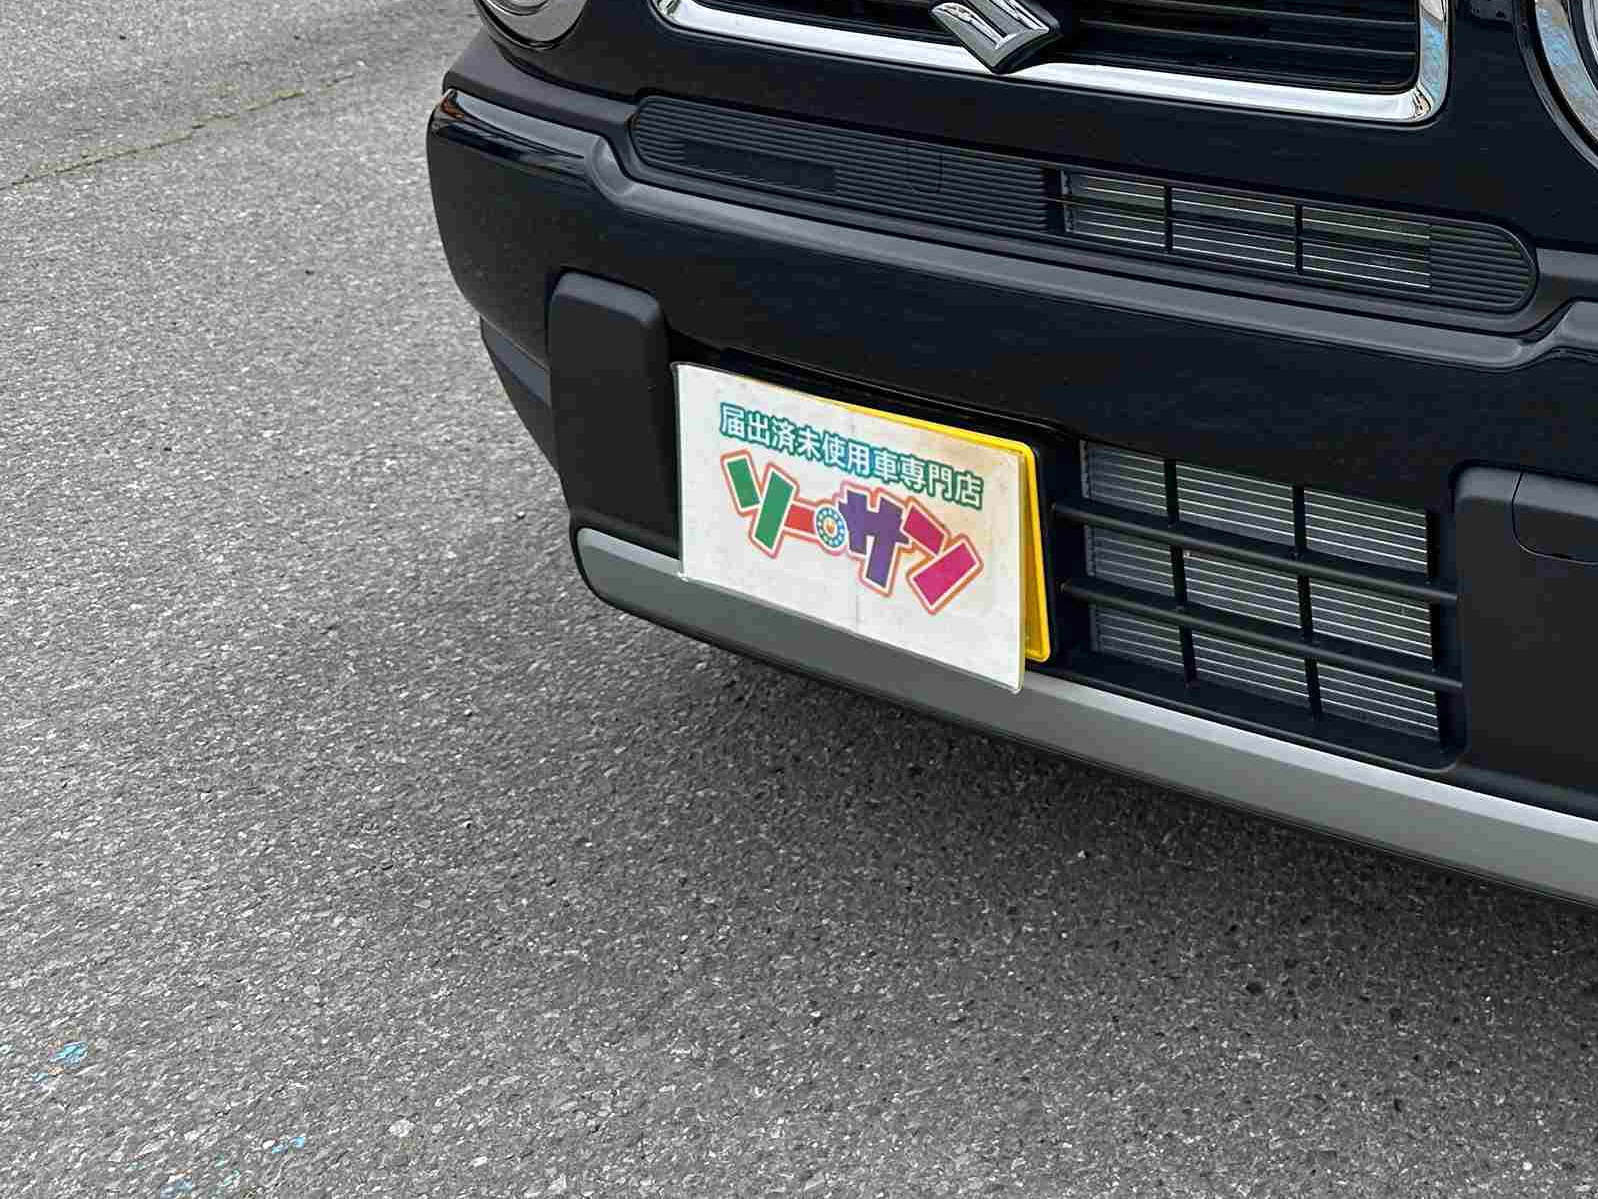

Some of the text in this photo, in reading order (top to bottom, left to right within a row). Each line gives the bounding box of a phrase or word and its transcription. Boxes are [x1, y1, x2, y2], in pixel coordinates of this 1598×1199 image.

[719, 403, 984, 511] 届出済未使用車専門店
[720, 449, 984, 616] ソーサン
